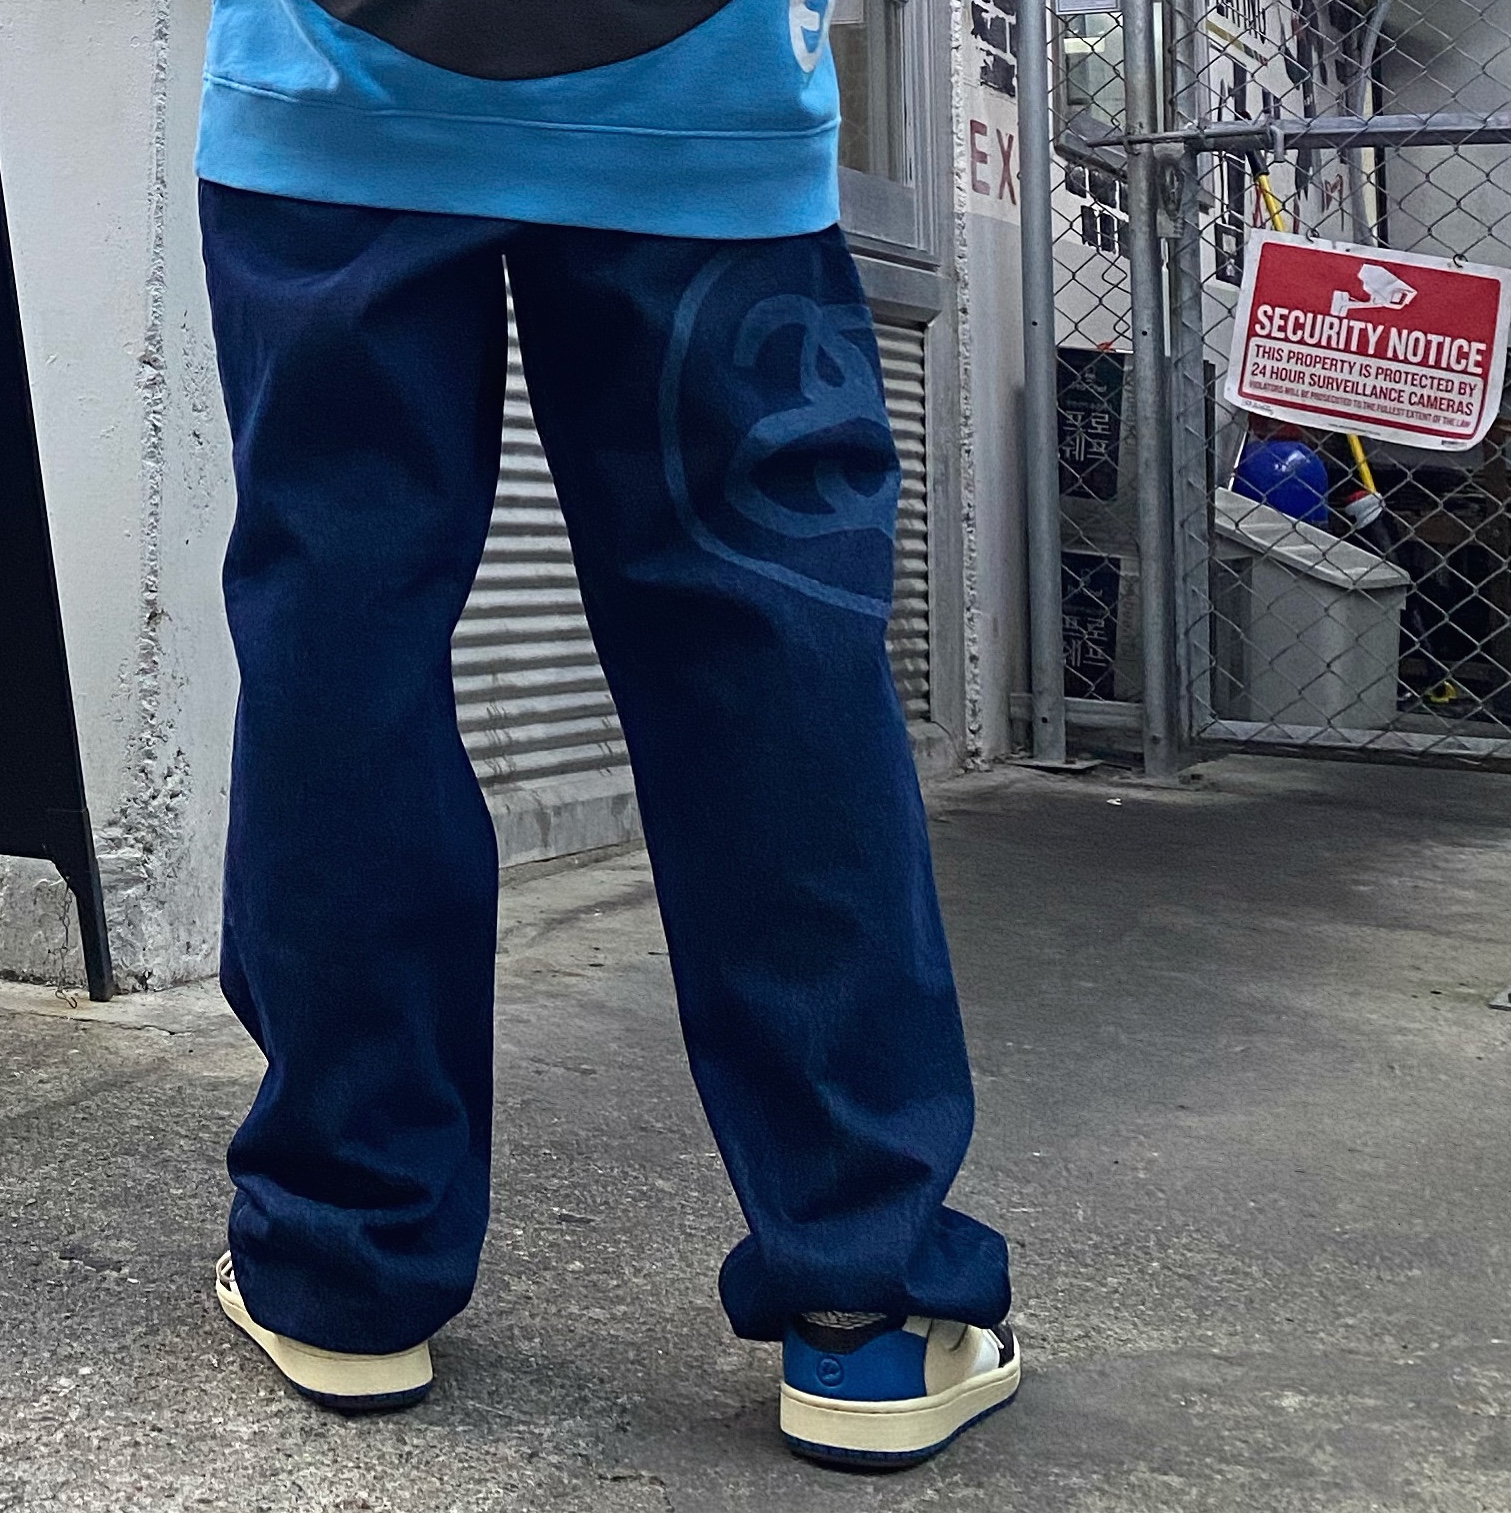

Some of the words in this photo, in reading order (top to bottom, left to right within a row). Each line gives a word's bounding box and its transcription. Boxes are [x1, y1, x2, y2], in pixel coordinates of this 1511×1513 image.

[1254, 304, 1384, 355] SECURITY
[1387, 326, 1487, 375] NOTICE
[1251, 362, 1267, 378] 24
[1269, 365, 1306, 384] HOUR
[1308, 372, 1405, 405] SURVEILLANCE
[1407, 391, 1474, 417] CAMERAS
[1255, 344, 1285, 362] THIS
[1287, 349, 1358, 376] PROPERTY
[1358, 363, 1372, 378] IS
[1375, 367, 1454, 394] PROTECTED
[1457, 381, 1478, 398] BY
